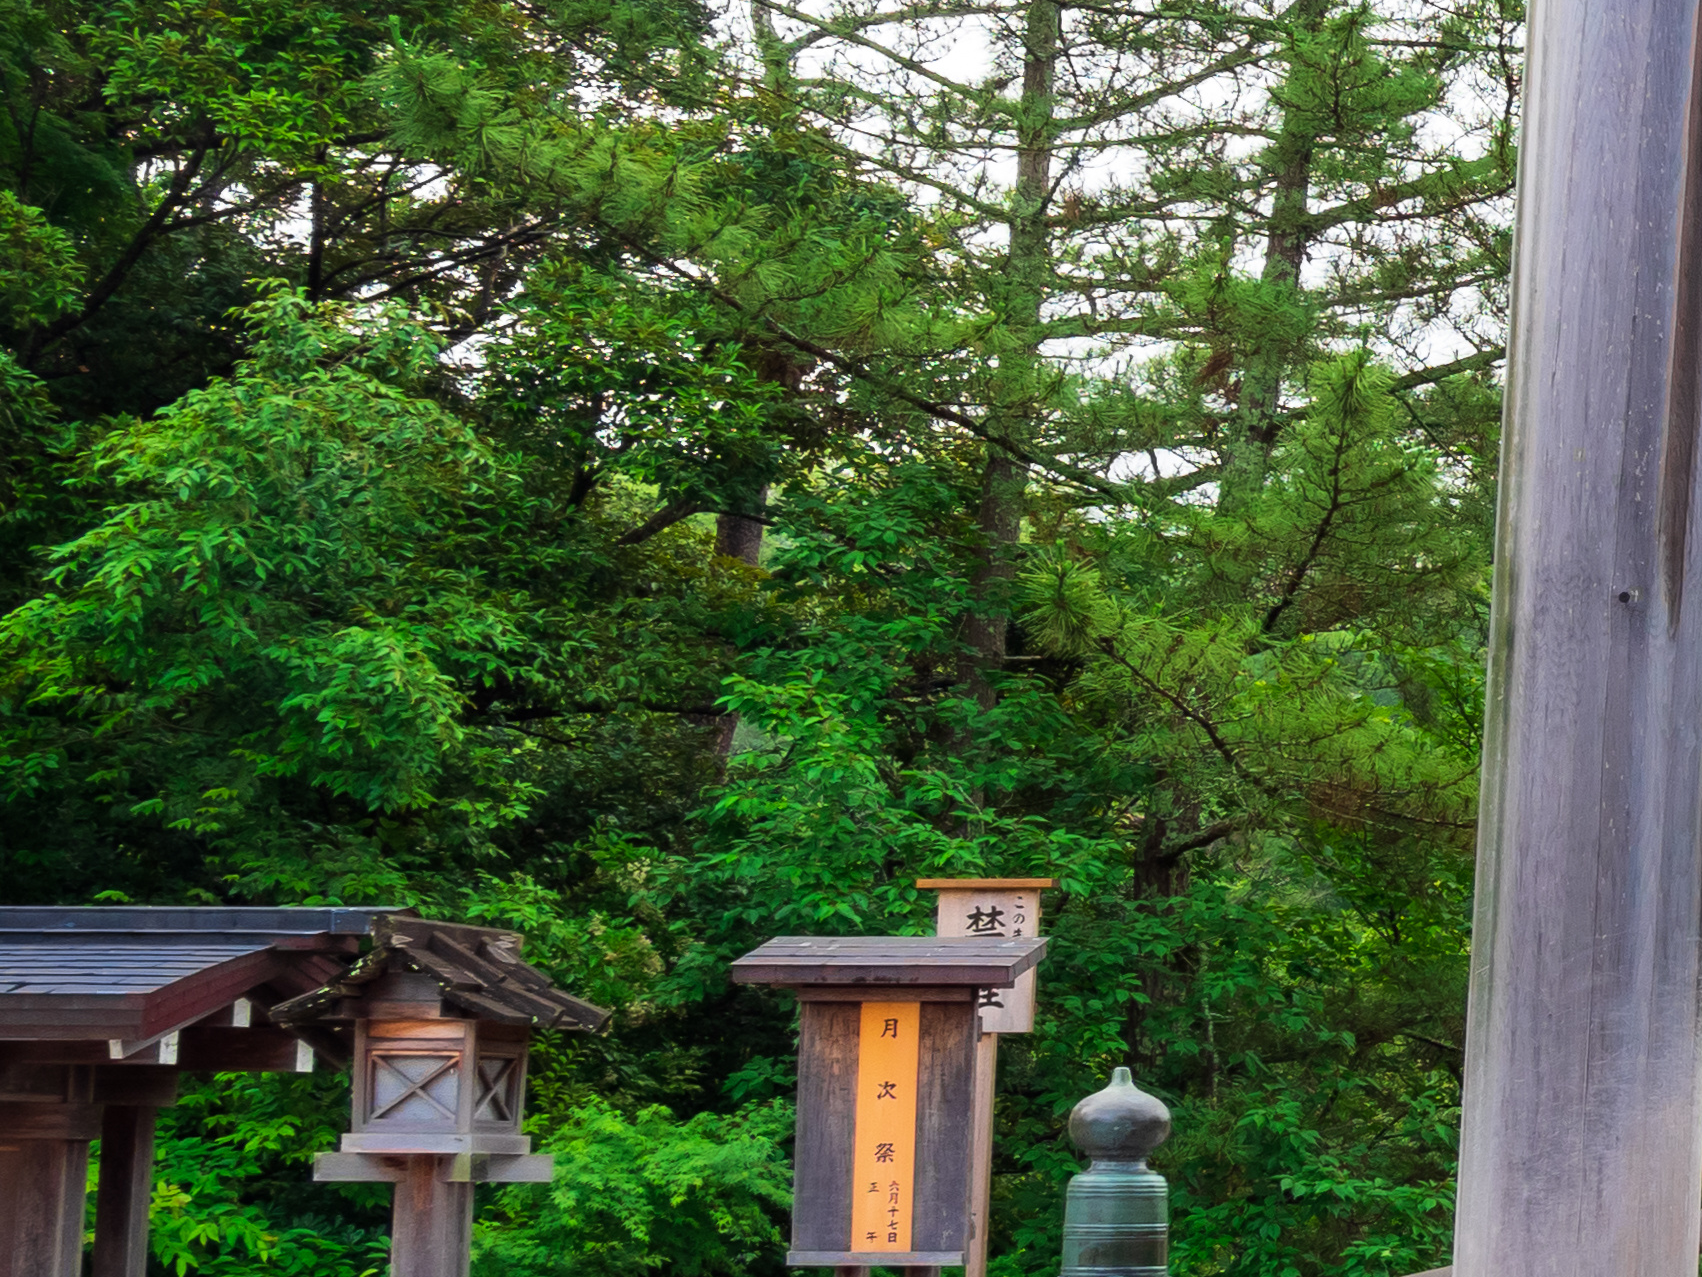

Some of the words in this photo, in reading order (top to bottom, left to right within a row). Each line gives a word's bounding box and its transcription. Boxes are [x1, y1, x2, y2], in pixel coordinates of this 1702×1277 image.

[874, 1017, 899, 1163] 月次祭
[887, 1180, 900, 1244] 六月十七日
